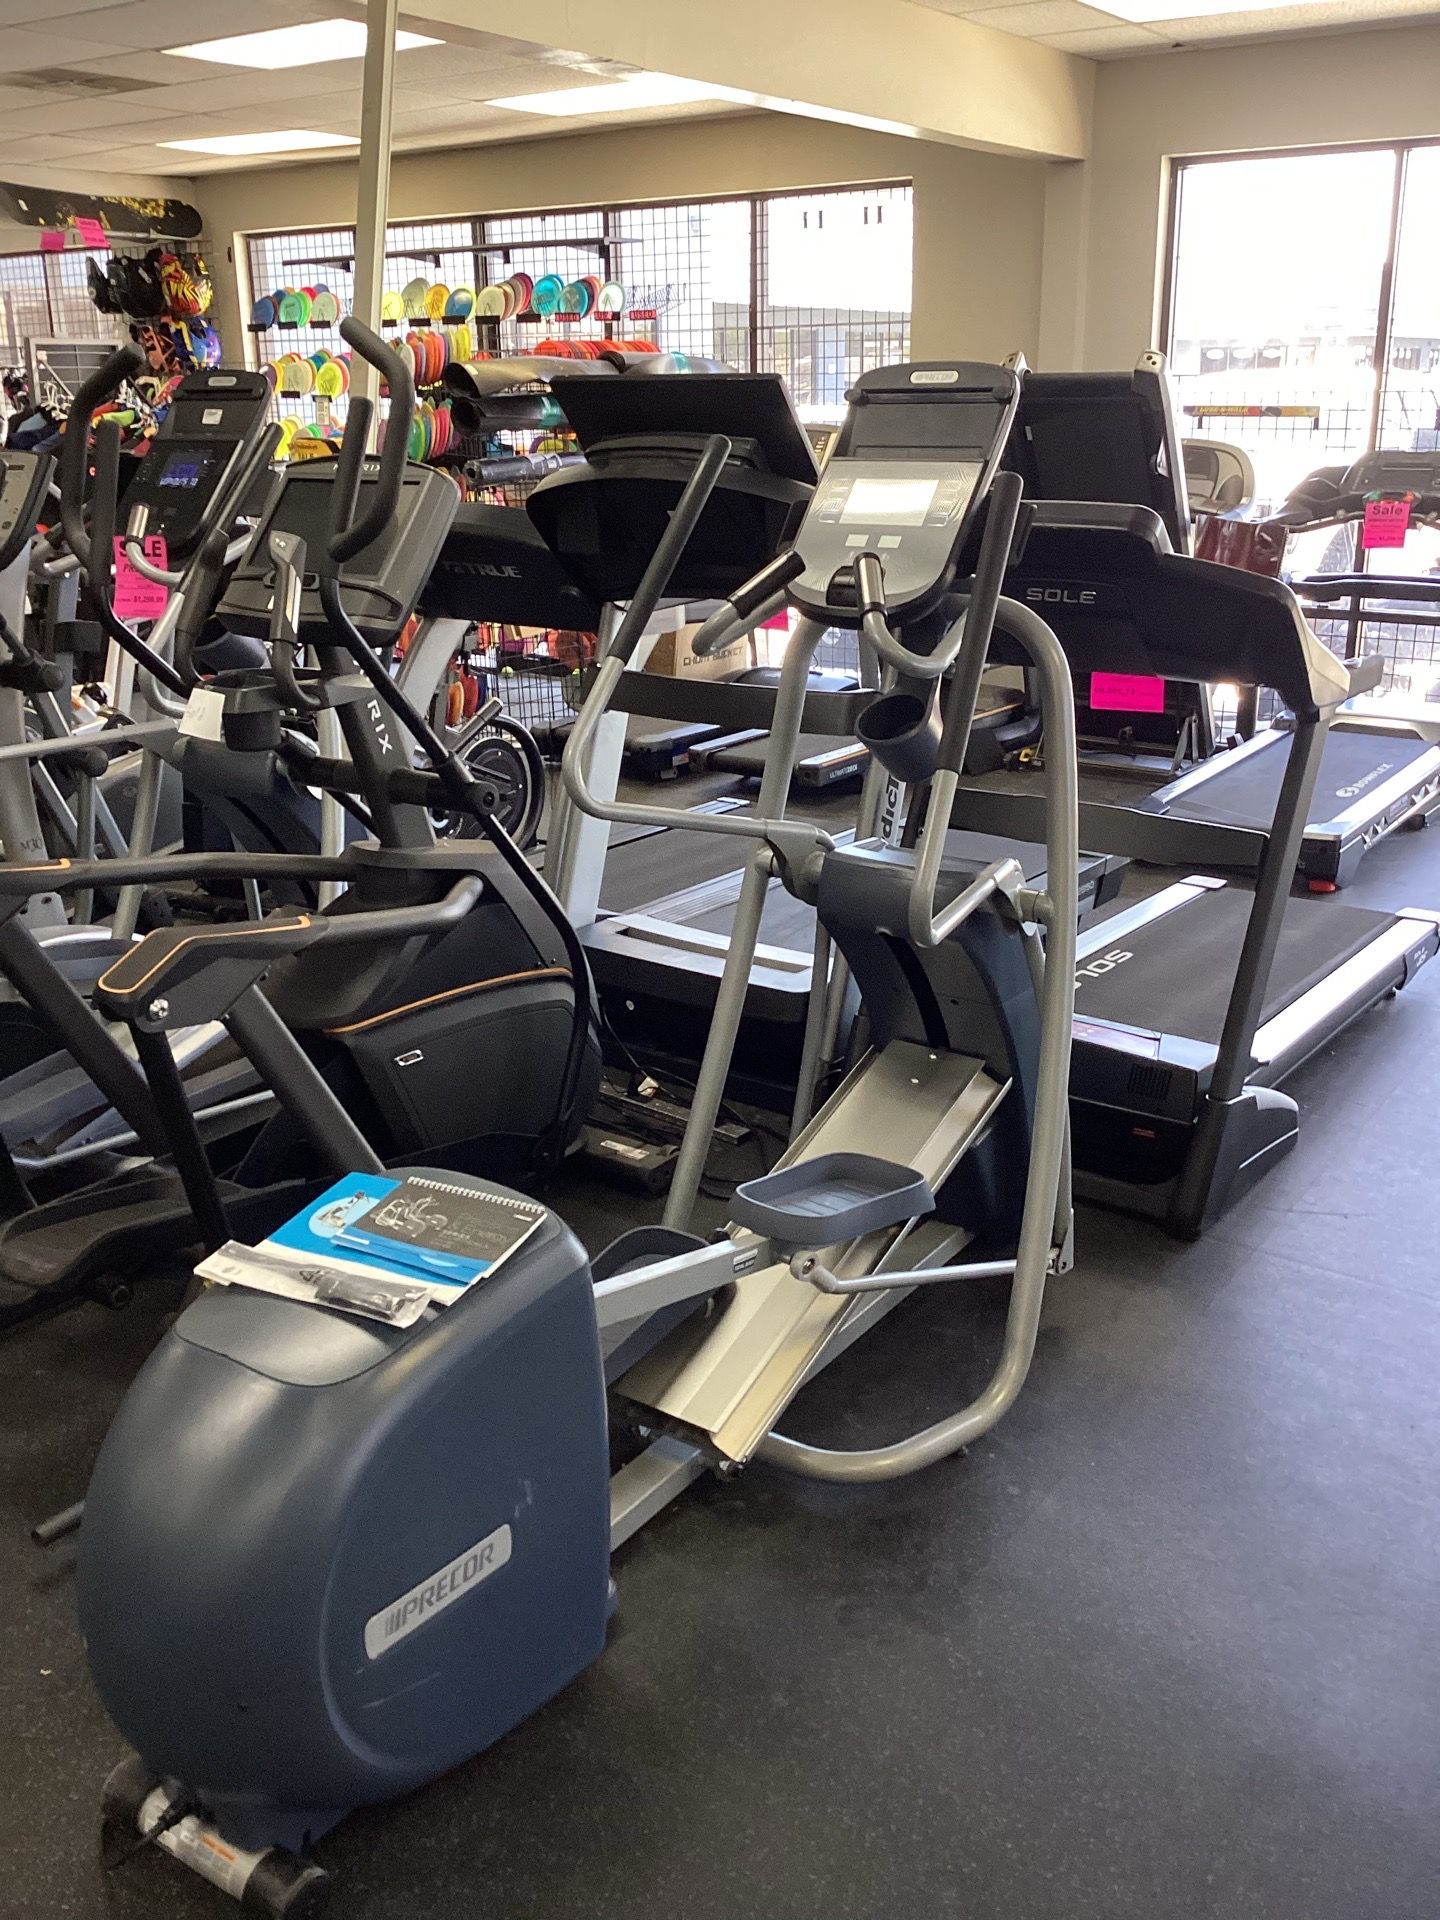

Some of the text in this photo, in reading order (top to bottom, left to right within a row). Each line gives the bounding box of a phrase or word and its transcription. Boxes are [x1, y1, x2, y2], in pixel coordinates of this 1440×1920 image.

[1372, 505, 1403, 516] Sale
[463, 562, 522, 578] TRUE
[1026, 587, 1097, 605] SOLE
[367, 699, 393, 755] RIX
[400, 1542, 495, 1627] PRECOR
